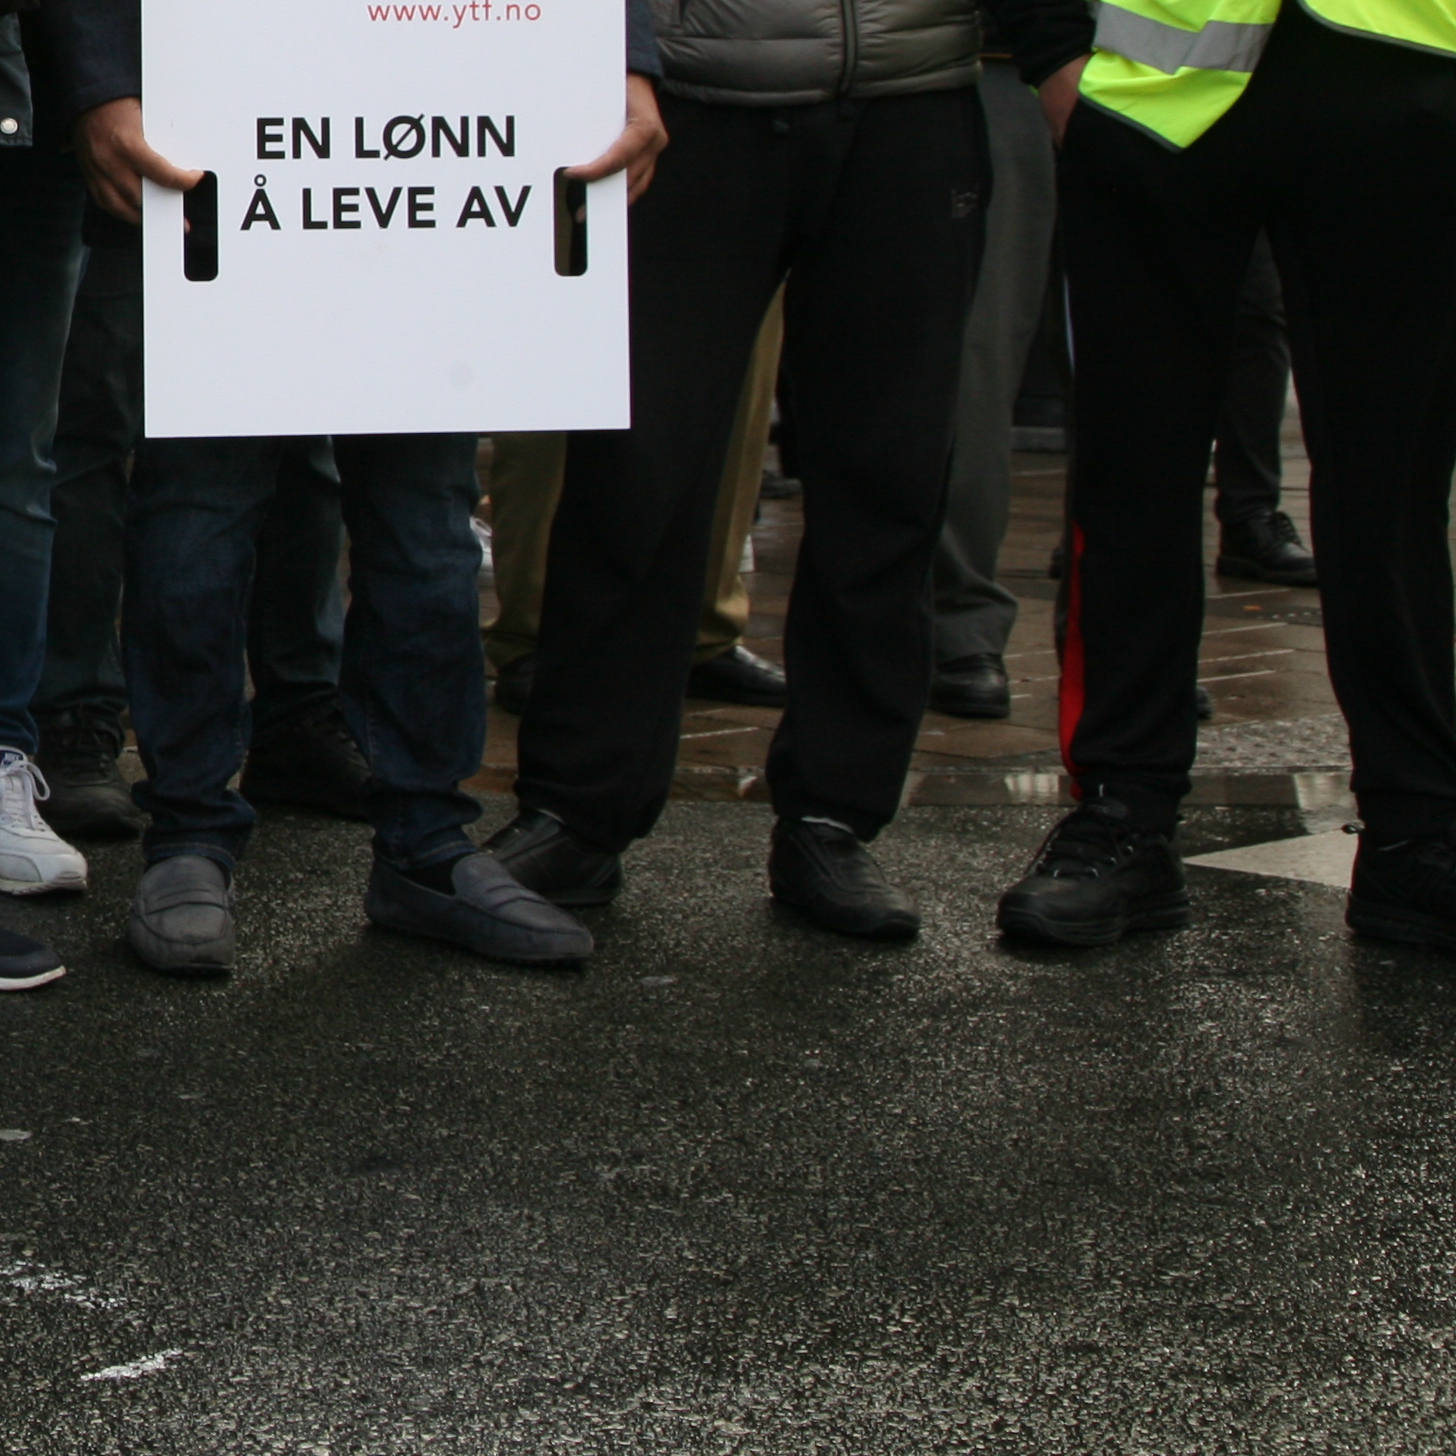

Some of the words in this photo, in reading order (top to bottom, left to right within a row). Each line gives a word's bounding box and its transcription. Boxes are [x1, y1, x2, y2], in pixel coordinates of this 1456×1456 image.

[257, 117, 330, 160] EN
[355, 113, 516, 161] LØNN
[240, 174, 282, 231] Å
[302, 186, 437, 231] LEVE
[456, 185, 533, 229] AV
